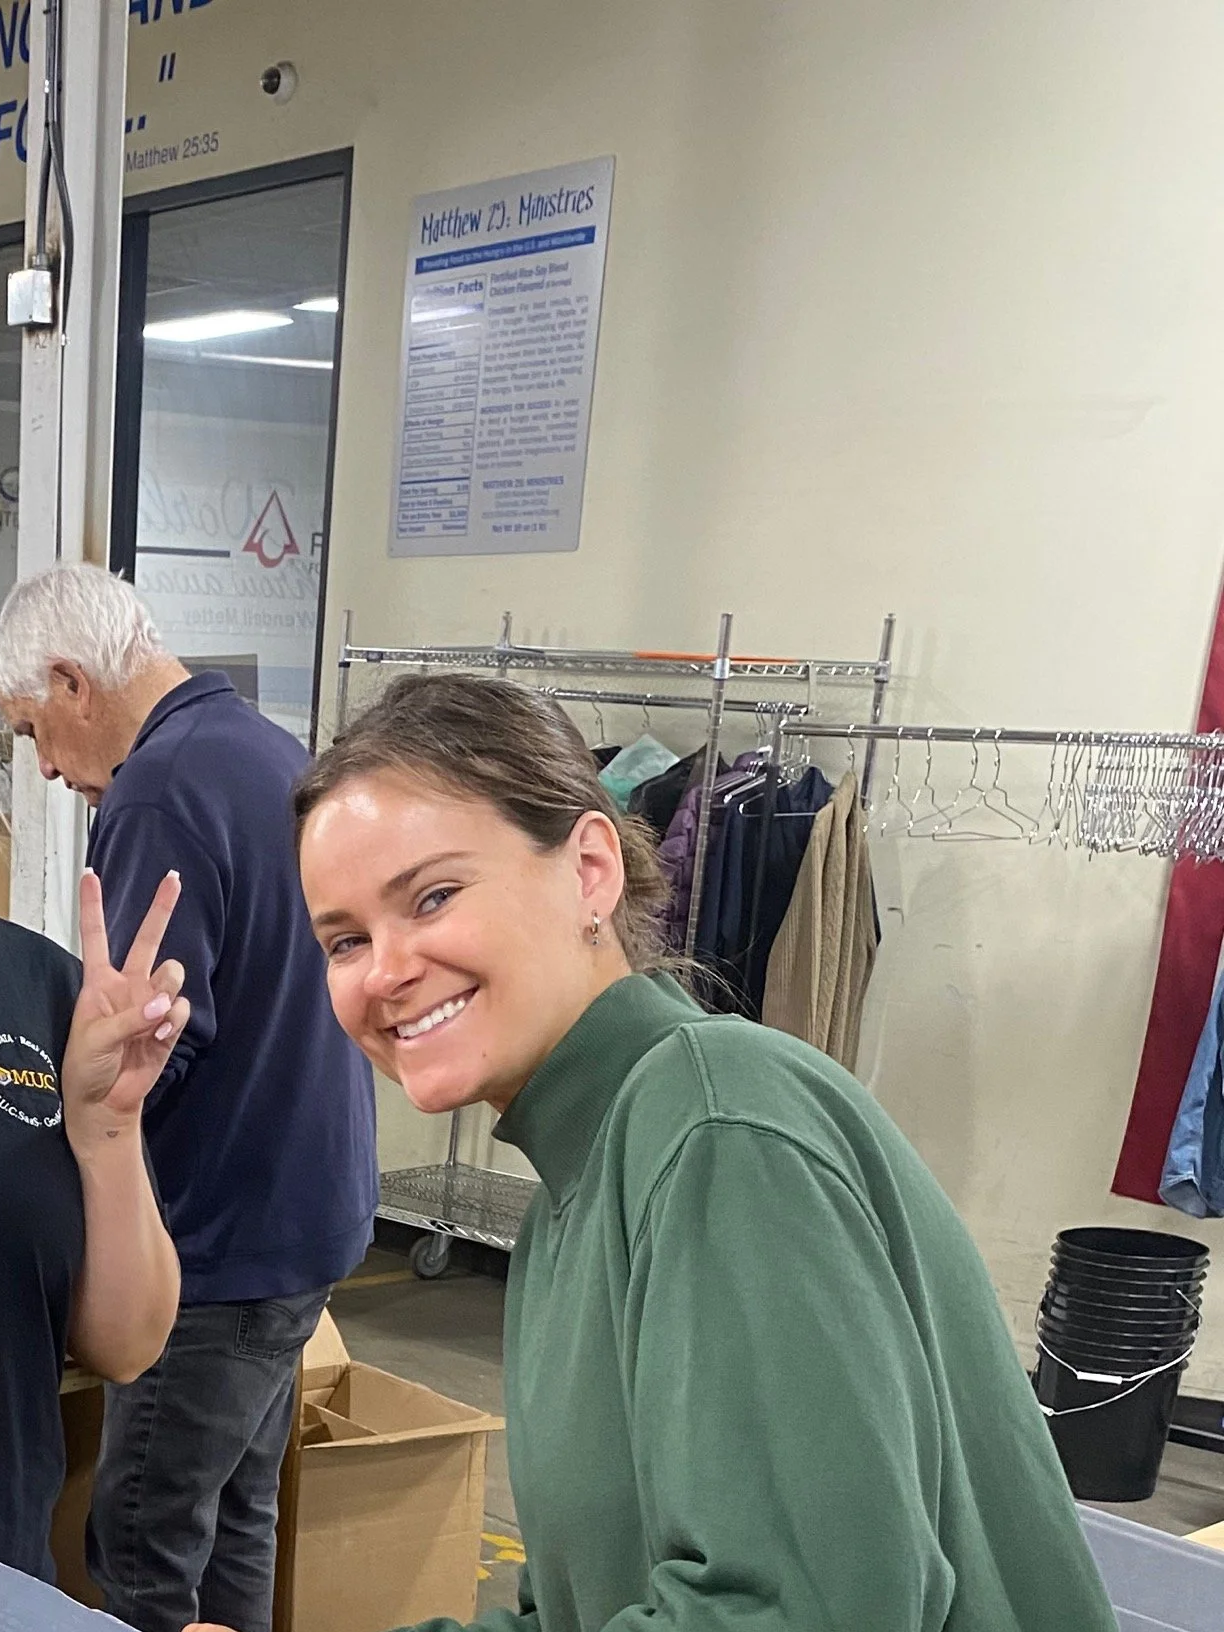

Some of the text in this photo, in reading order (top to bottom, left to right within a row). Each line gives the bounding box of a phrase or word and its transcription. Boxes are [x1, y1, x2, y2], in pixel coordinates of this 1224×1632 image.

[126, 131, 219, 172] Matthew 25:35
[421, 204, 482, 246] Matthew
[519, 183, 595, 228] Ministries
